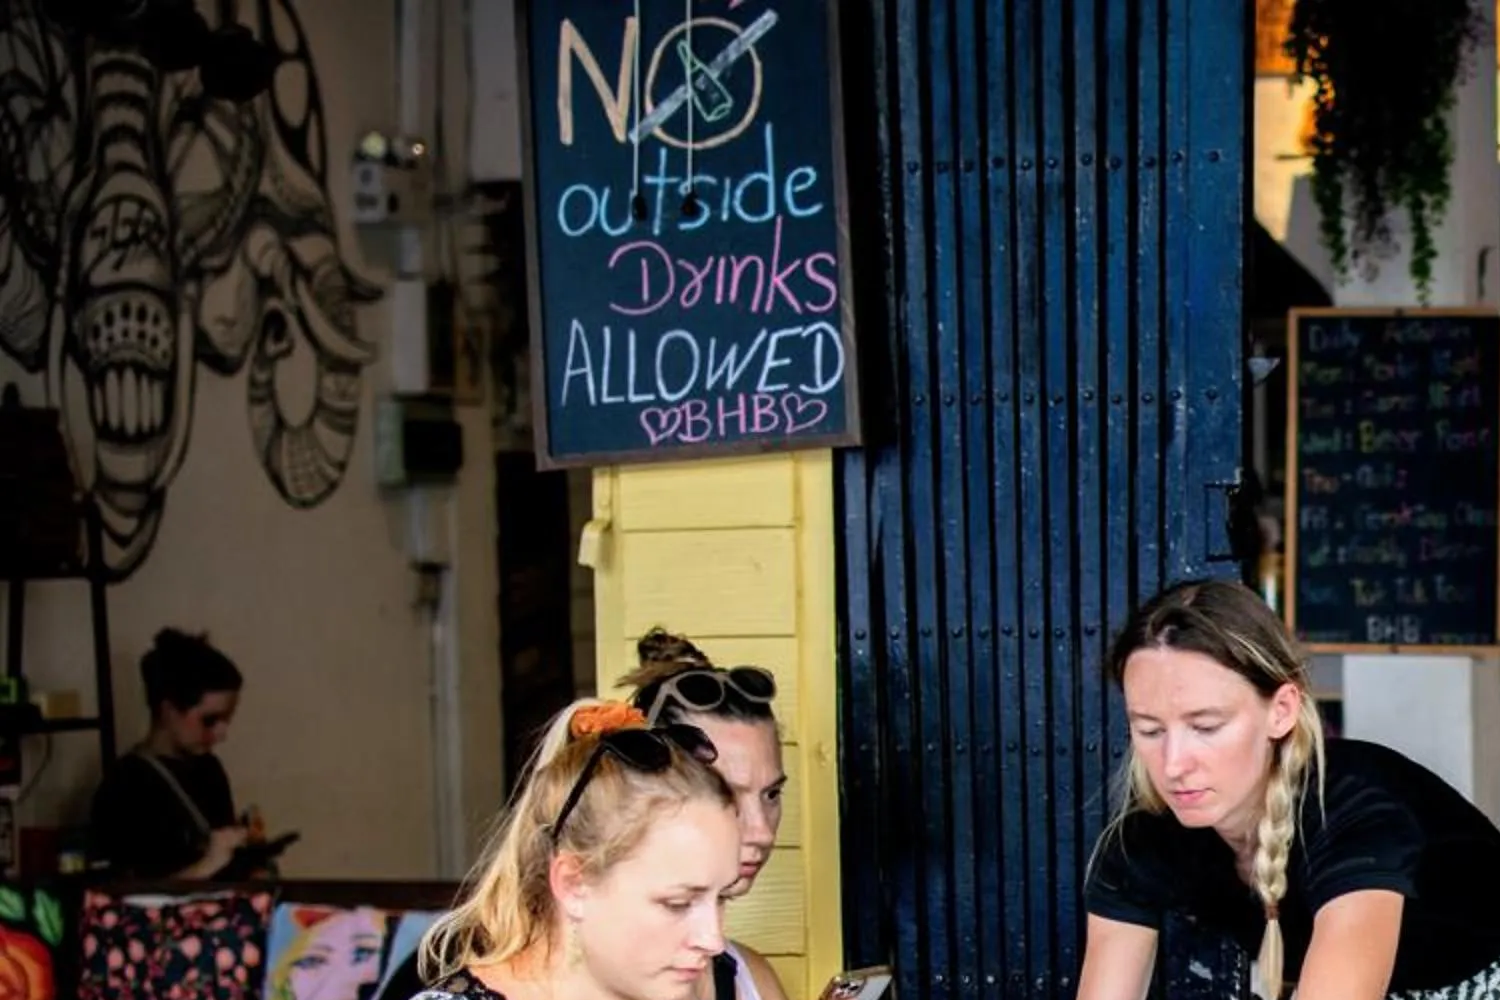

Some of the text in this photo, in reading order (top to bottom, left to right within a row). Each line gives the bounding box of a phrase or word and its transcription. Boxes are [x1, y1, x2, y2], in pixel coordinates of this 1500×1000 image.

[559, 15, 763, 150] NO
[557, 122, 824, 238] outside
[608, 213, 838, 315] Drinks
[560, 318, 846, 407] ALLOWED
[676, 392, 779, 443] BHB
